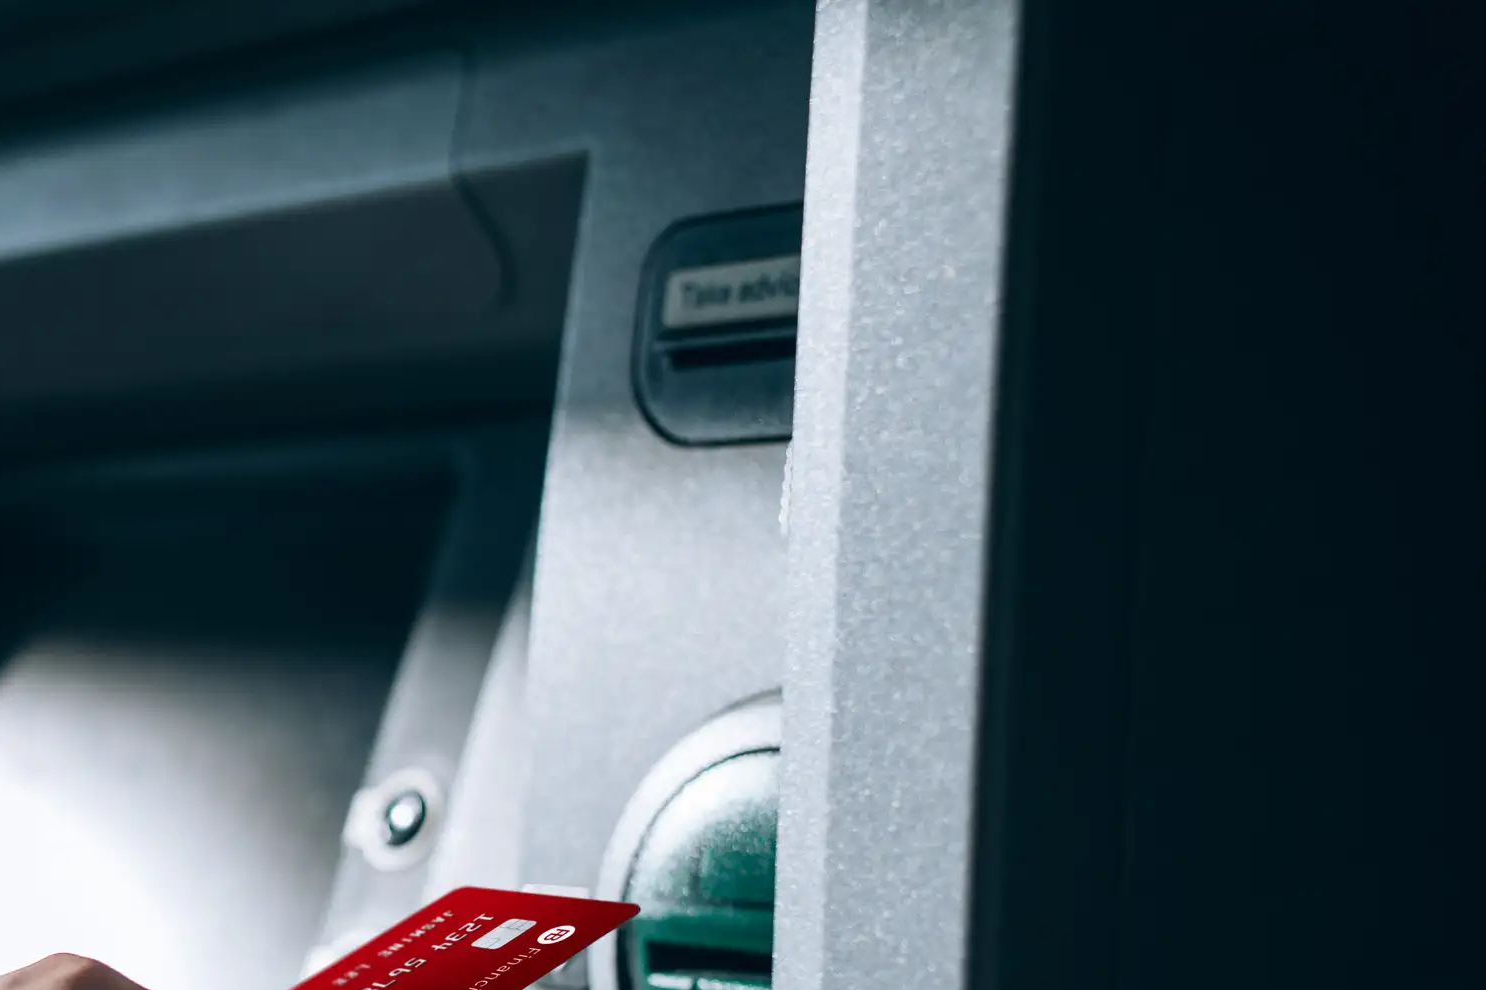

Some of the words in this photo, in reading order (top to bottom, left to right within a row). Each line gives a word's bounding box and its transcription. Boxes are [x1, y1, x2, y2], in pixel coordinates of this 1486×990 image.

[377, 909, 455, 959] JASMINE
[431, 912, 495, 951] 1234
[331, 962, 372, 986] LEE
